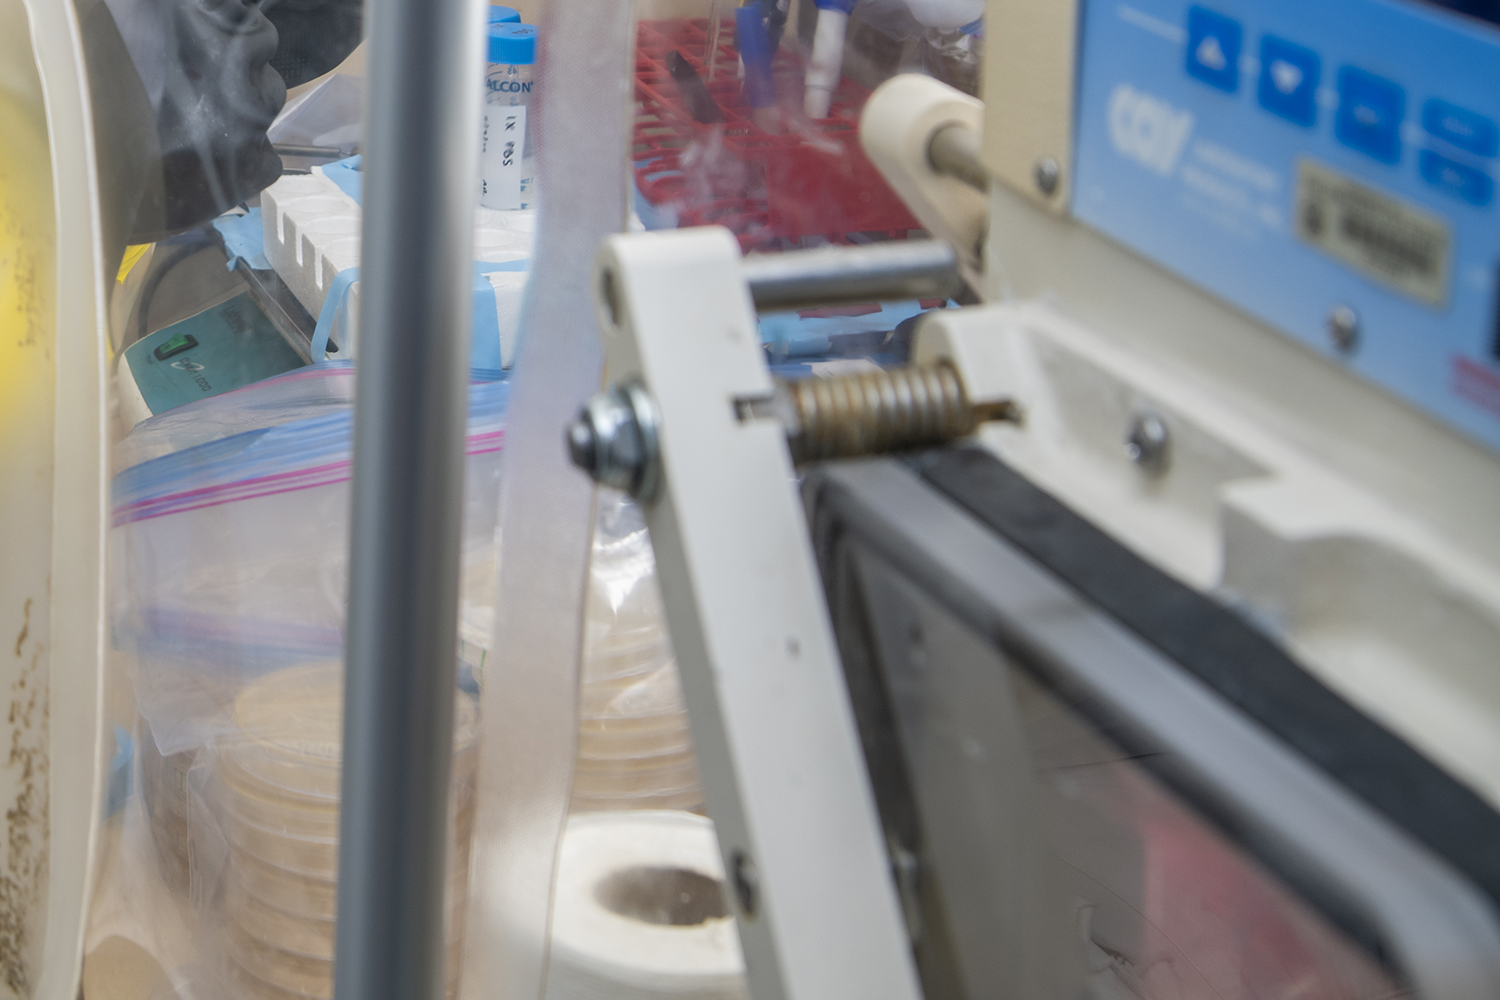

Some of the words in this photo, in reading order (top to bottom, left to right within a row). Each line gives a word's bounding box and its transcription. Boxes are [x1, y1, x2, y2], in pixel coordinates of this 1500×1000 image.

[486, 79, 531, 93] ALCON
[502, 141, 516, 167] PBS
[195, 373, 212, 392] 1000
